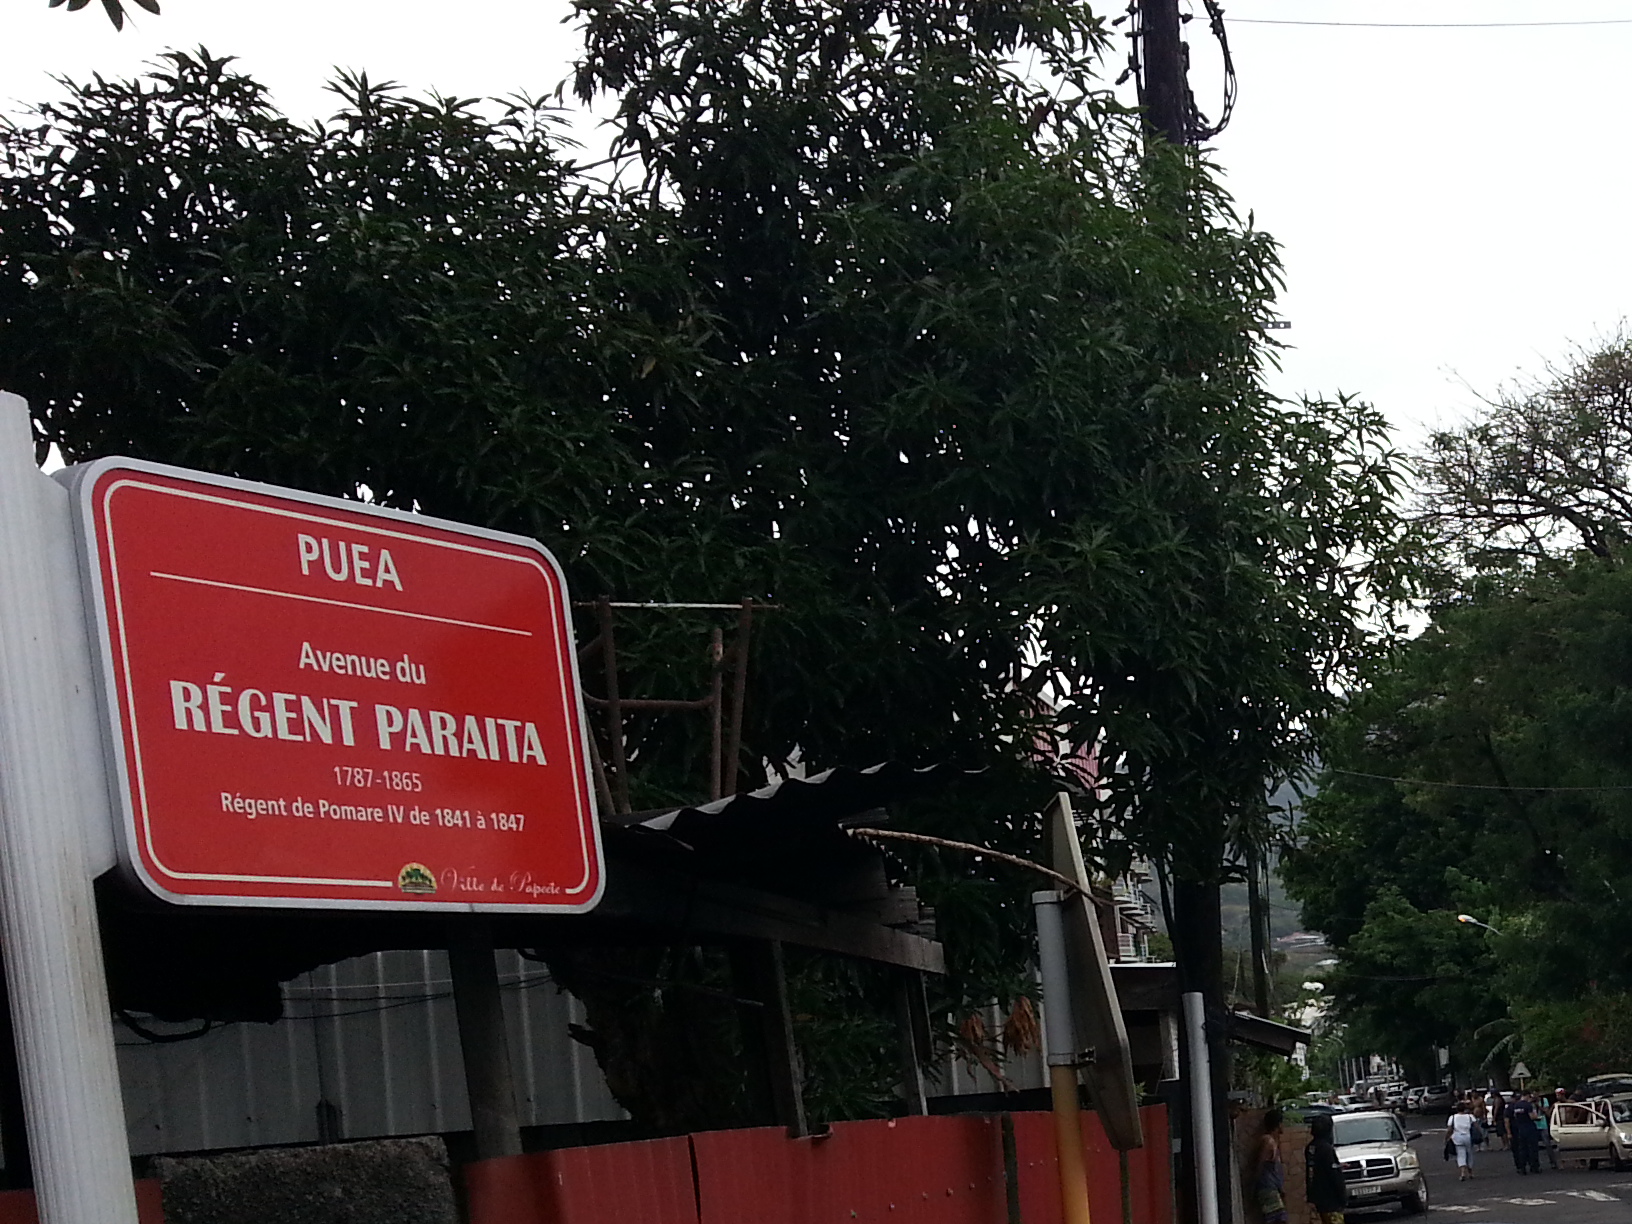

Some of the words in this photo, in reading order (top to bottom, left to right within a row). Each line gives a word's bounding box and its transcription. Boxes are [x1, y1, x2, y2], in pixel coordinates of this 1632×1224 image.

[297, 533, 403, 592] PUEA
[299, 641, 390, 680] Avenue
[395, 654, 426, 684] du
[169, 672, 357, 746] RÉGENT
[375, 703, 547, 766] PARAITA
[333, 766, 422, 792] 1787-1865
[220, 792, 287, 818] Régent
[292, 797, 314, 817] de
[319, 799, 383, 822] Pomare
[387, 804, 404, 823] IV
[409, 806, 430, 825] de
[435, 809, 471, 828] 1841
[476, 811, 486, 828] à
[490, 813, 525, 831] 1847
[441, 866, 485, 892] Ville
[490, 877, 504, 892] de
